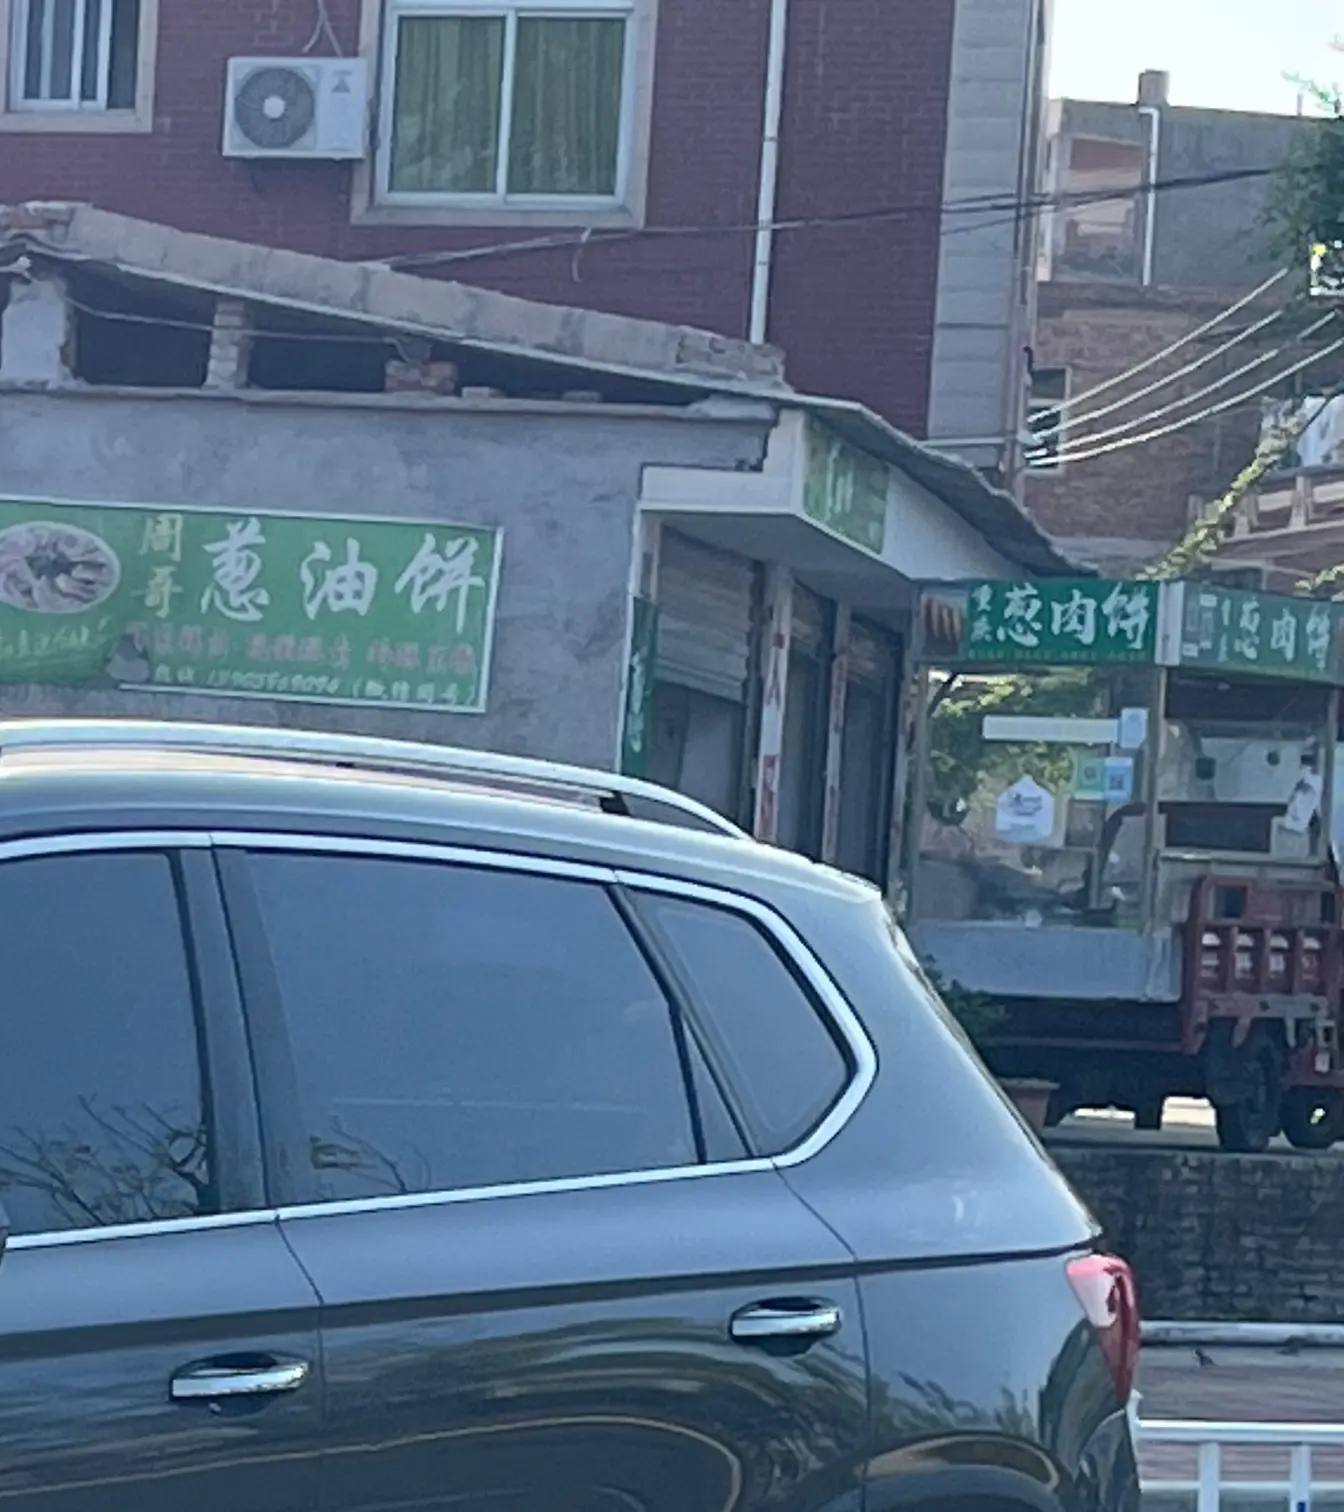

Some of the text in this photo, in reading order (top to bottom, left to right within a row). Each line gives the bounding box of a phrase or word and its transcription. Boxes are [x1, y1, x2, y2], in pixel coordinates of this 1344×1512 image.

[131, 513, 183, 619] 周哥
[199, 516, 484, 633] 葱油饼
[996, 581, 1150, 651] 葱肉饼
